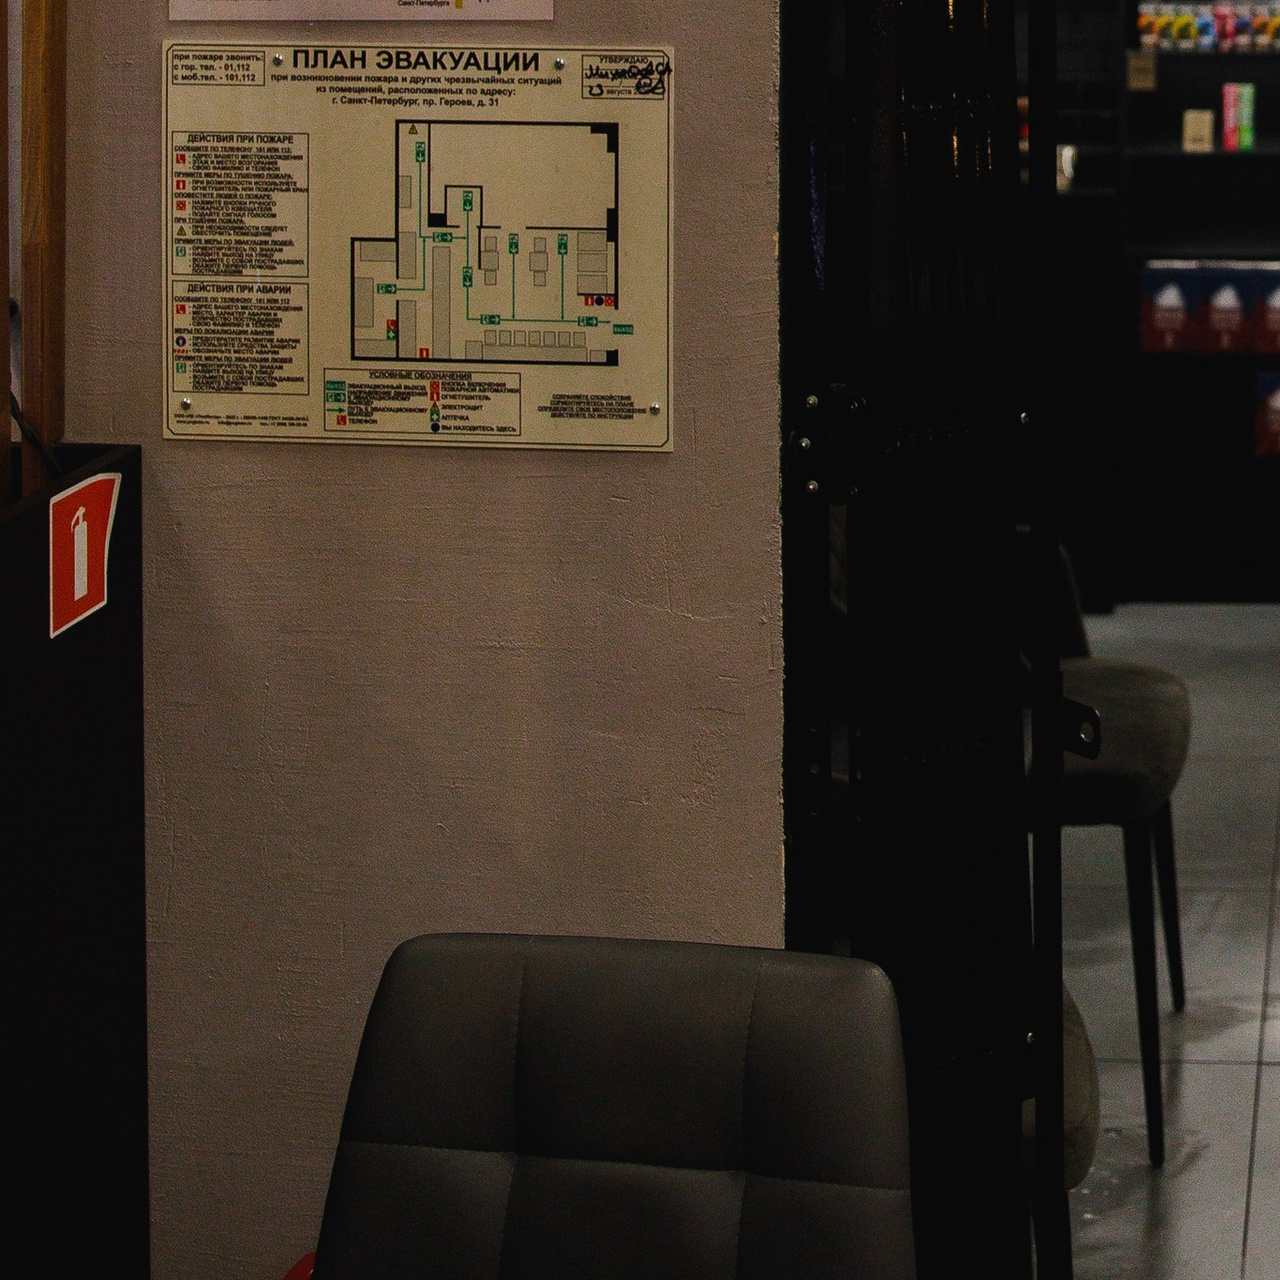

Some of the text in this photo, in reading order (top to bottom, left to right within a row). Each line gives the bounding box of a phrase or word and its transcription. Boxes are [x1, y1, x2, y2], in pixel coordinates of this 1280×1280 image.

[224, 63, 249, 71] 01,112
[293, 49, 538, 74] ПЛАН ЭВАКУАЦИИ
[225, 73, 255, 81] 101,112
[271, 74, 287, 82] при
[409, 76, 440, 84] других
[444, 75, 514, 85] чрезвычайных
[518, 76, 561, 86] ситуаций
[329, 85, 386, 94] помещений,
[388, 87, 462, 95] расположенных
[480, 88, 515, 96] адресу:
[340, 95, 419, 106] Санкт-Петербург,
[439, 97, 474, 106] Героев,
[489, 96, 498, 105] 31
[187, 133, 293, 144] ДЕЙСТВИЯ ПРИ ПОЖАРЕ
[187, 283, 291, 294] ДЕЙСТВИЯ ПРИ АВАРИИ
[369, 370, 472, 380] УСЛОВНЫЕ ОБОЗНАЧЕНИЯ
